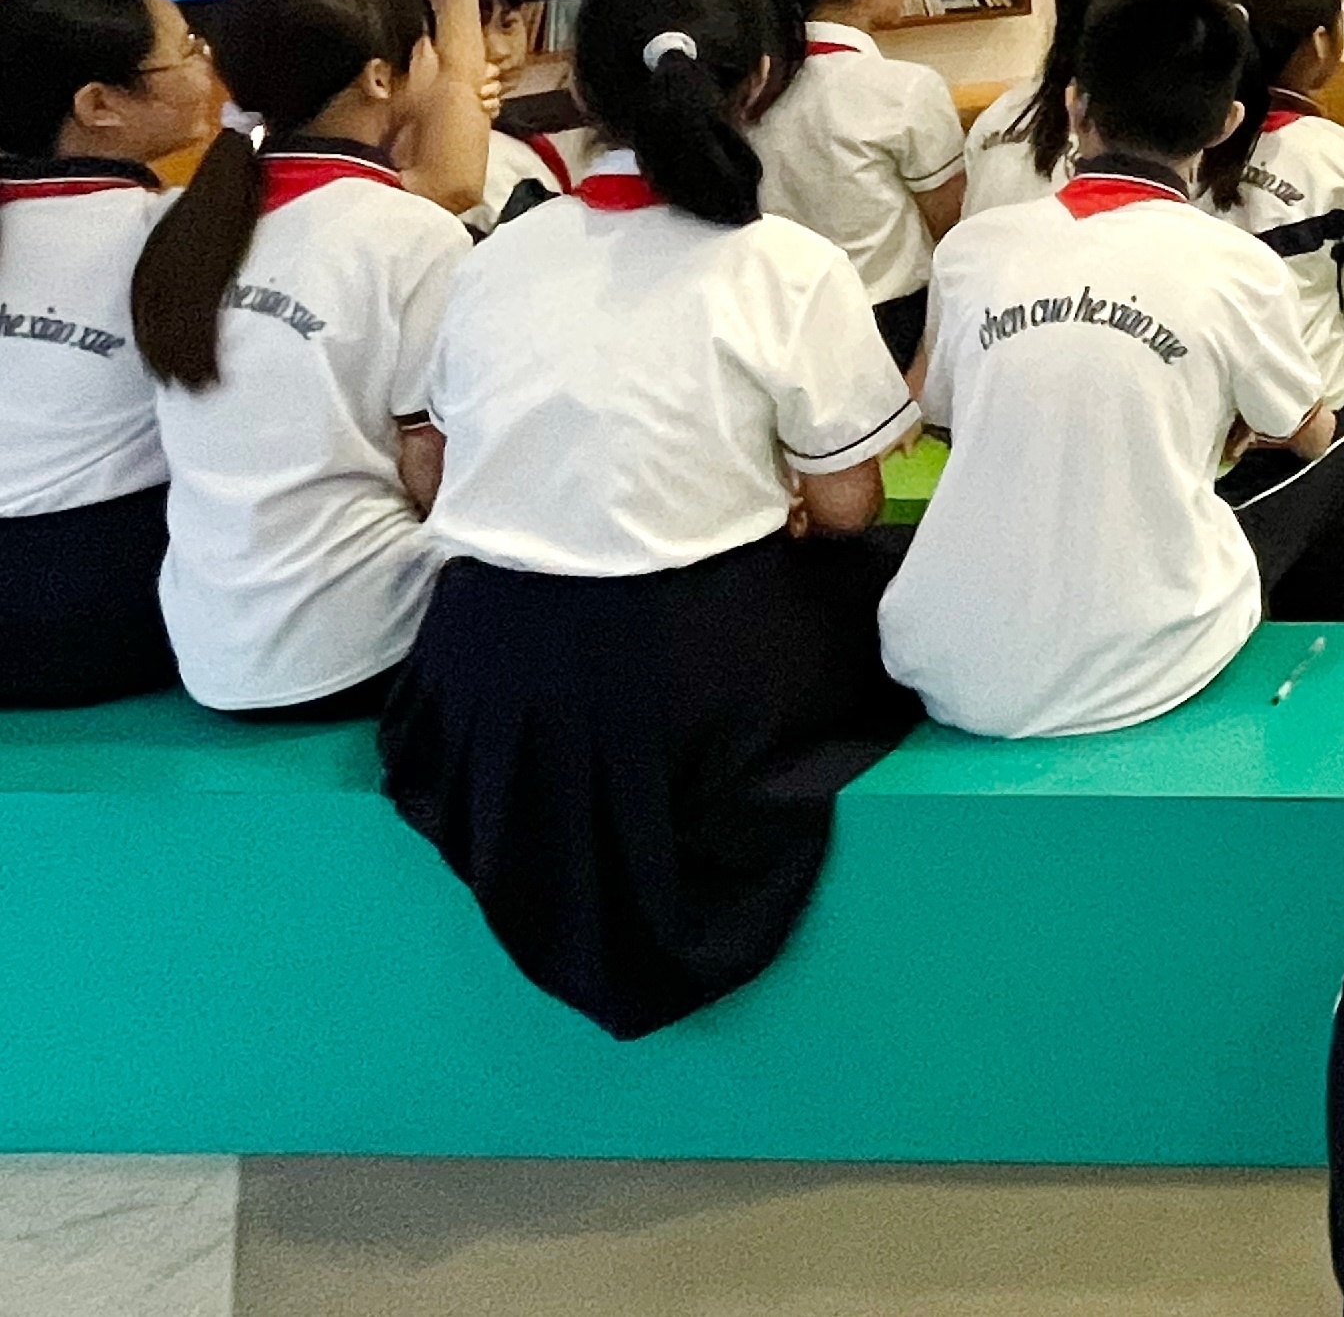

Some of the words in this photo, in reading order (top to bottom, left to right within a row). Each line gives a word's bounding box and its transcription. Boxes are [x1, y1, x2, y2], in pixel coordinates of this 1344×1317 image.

[979, 304, 1028, 351] chen
[1031, 295, 1073, 327] cuo
[1073, 285, 1107, 325] he
[1102, 294, 1154, 339] xiao
[1141, 323, 1189, 365] xue
